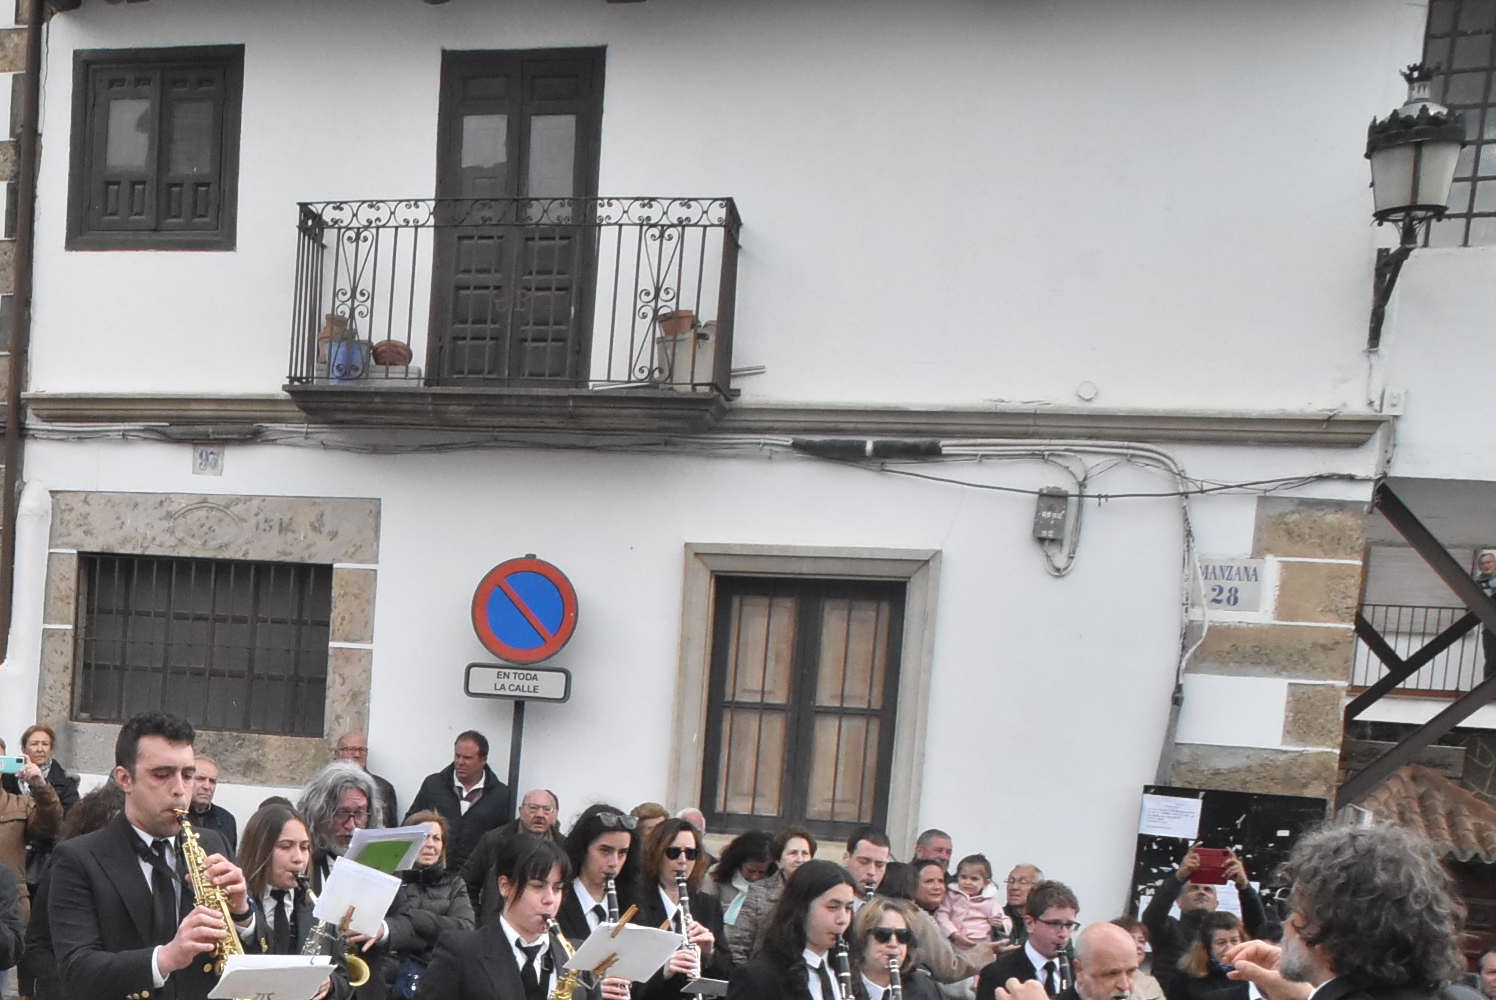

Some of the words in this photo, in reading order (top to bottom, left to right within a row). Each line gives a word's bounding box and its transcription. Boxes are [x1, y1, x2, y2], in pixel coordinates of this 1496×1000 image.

[1200, 564, 1259, 582] MANZANA
[1210, 584, 1239, 606] 28
[496, 671, 510, 680] EN
[513, 671, 539, 681] TODA
[494, 683, 506, 691] LA
[508, 684, 540, 693] CALLE
